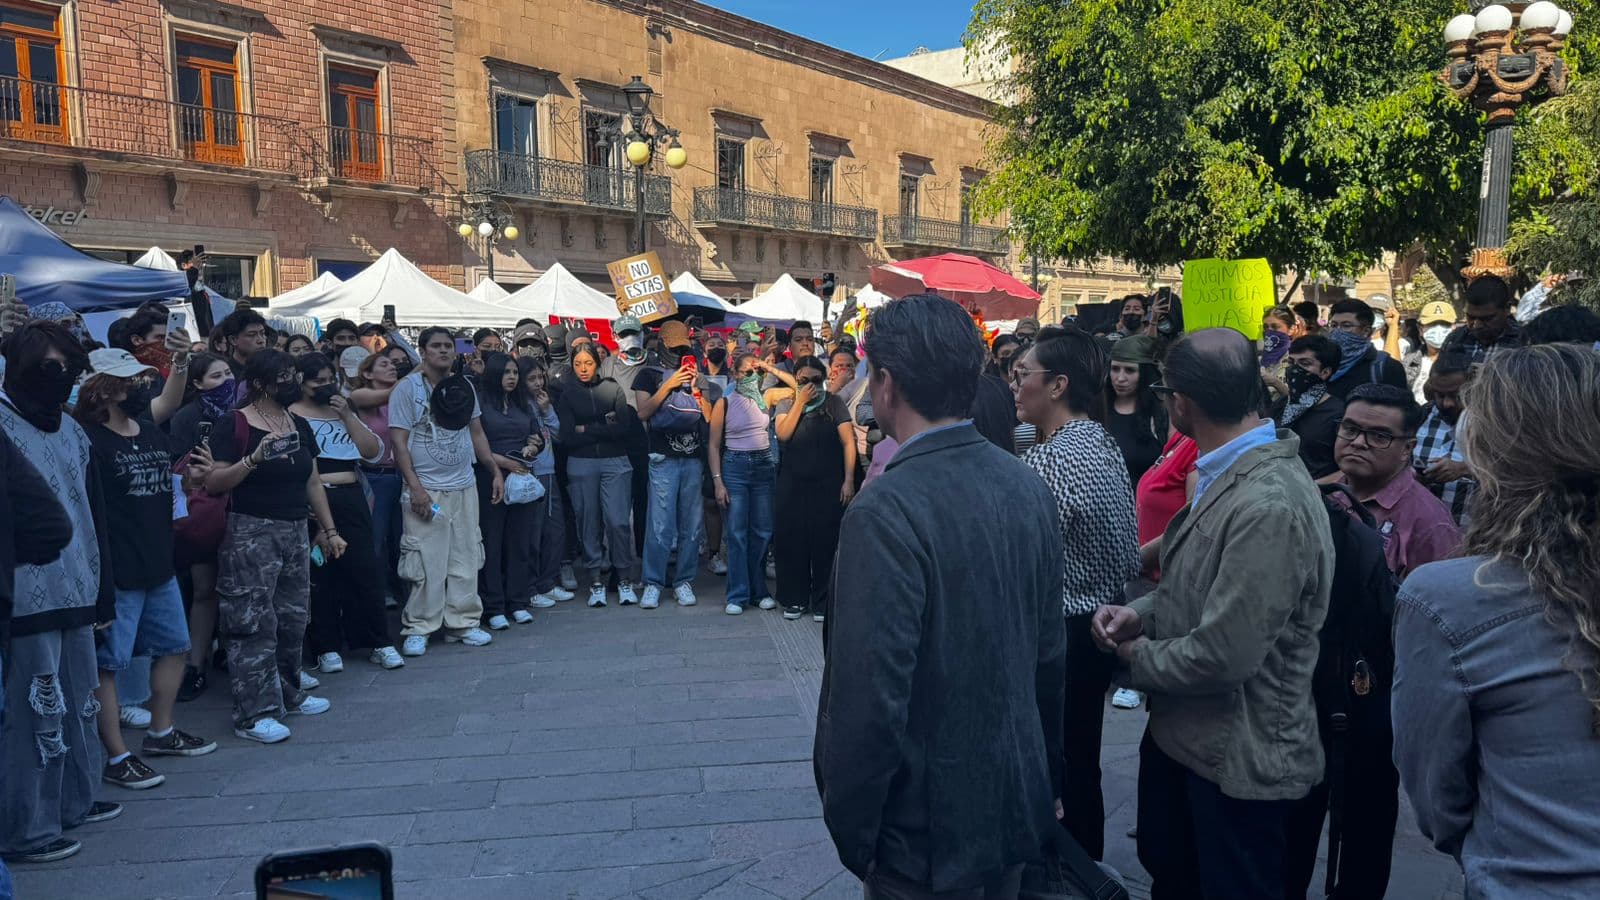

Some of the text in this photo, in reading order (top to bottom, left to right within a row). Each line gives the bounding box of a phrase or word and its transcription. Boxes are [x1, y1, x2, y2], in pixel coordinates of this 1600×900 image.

[630, 262, 650, 278] NO
[625, 276, 663, 298] ESTAS
[1192, 285, 1262, 305] JUSTICIA
[628, 300, 656, 318] SOLA
[1433, 304, 1444, 315] A
